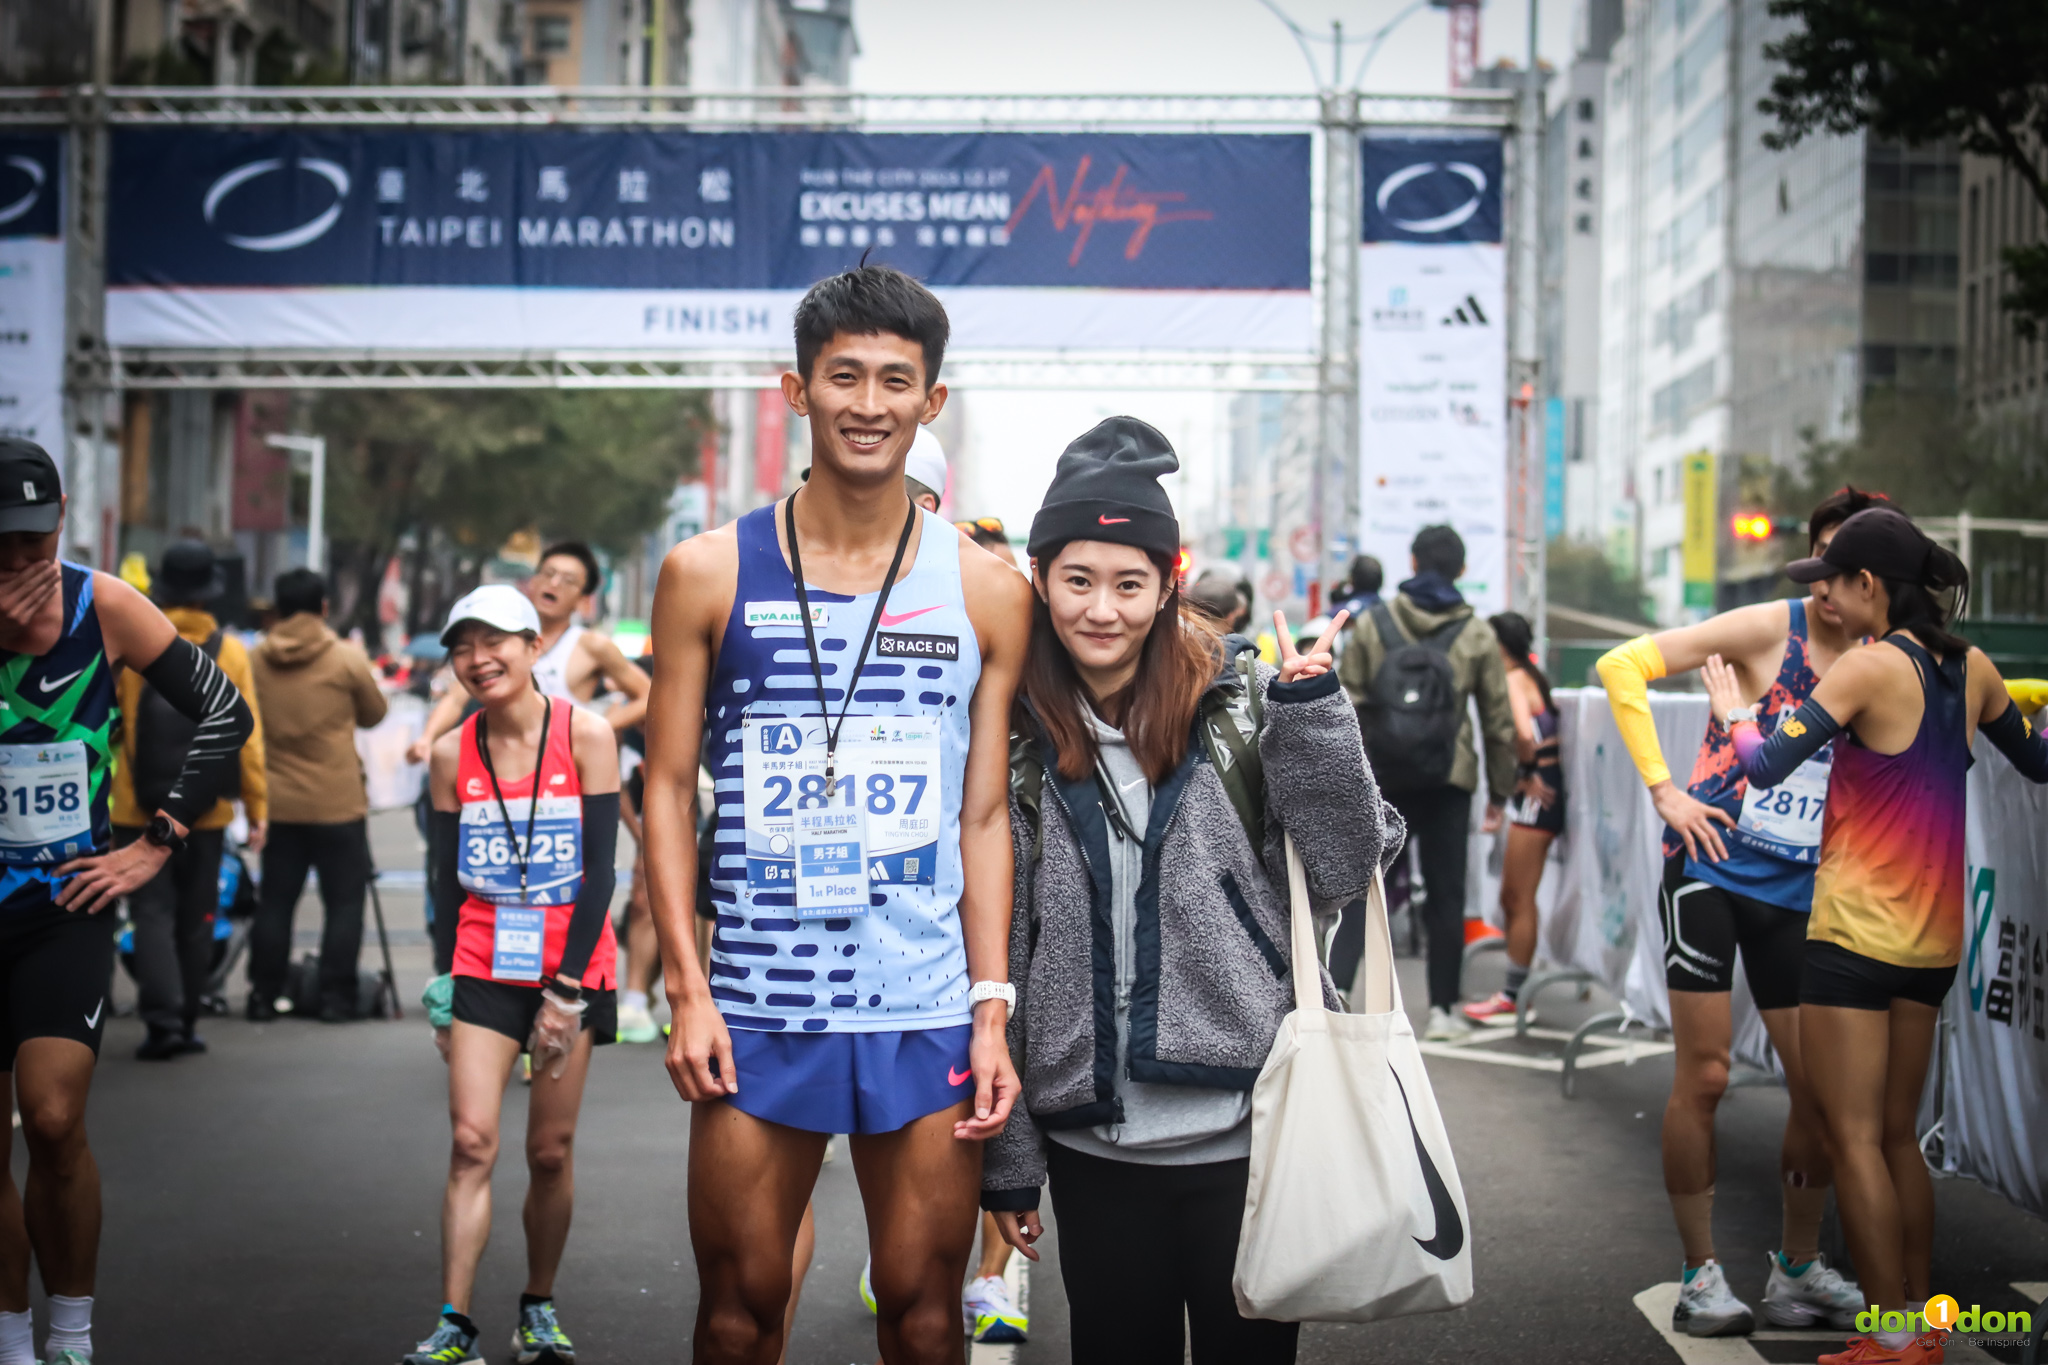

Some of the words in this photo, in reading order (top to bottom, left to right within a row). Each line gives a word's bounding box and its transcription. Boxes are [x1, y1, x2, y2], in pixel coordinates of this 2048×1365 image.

[801, 191, 926, 221] EXCUSES
[928, 191, 1011, 221] MEAN
[379, 215, 501, 247] TAIPEI
[518, 215, 735, 247] MARATHON
[643, 306, 770, 333] FINISH
[750, 613, 779, 621] EVA
[896, 640, 933, 653] RACE
[935, 642, 956, 654] ON
[775, 726, 798, 750] A
[763, 773, 928, 817] 28187
[800, 814, 857, 828] 半程馬拉松
[813, 846, 849, 860] 男子組
[824, 866, 840, 874] Male
[809, 885, 823, 898] 1st
[826, 884, 857, 897] Place
